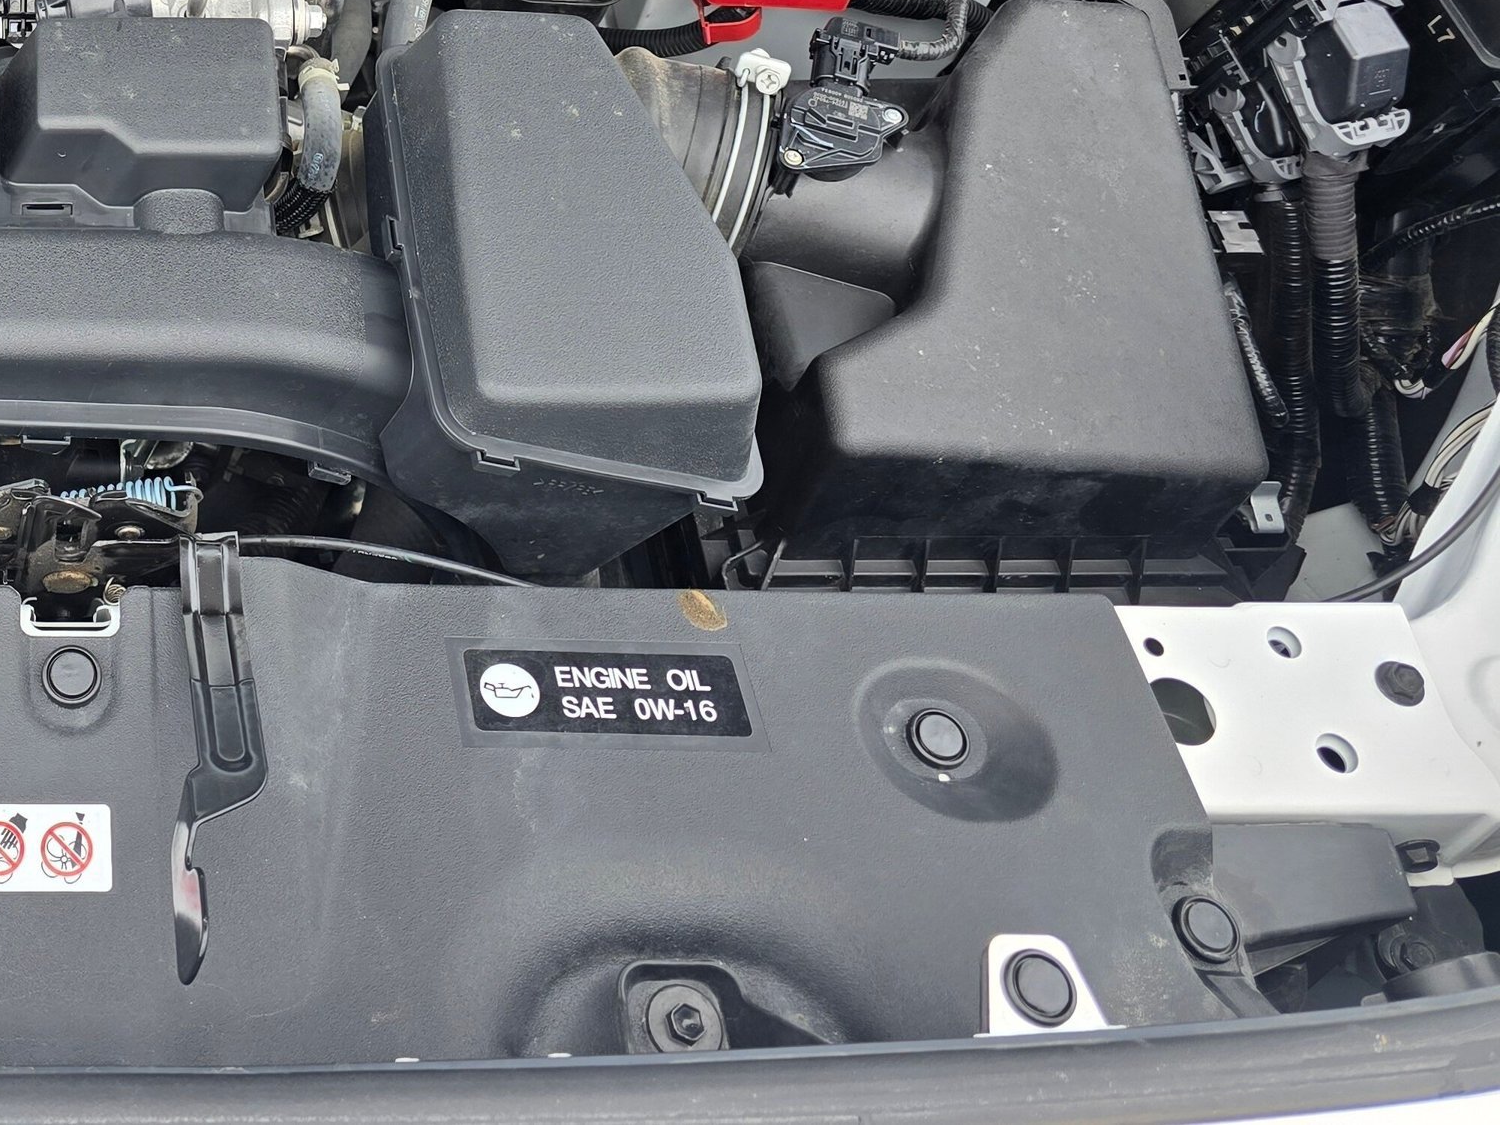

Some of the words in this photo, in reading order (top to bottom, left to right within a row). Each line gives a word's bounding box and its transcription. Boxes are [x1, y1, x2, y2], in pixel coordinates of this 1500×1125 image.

[1427, 15, 1455, 43] L7
[554, 666, 652, 690] ENGINE
[666, 669, 712, 692] OIL
[561, 695, 617, 719] SAE
[634, 697, 718, 723] 0W-16
